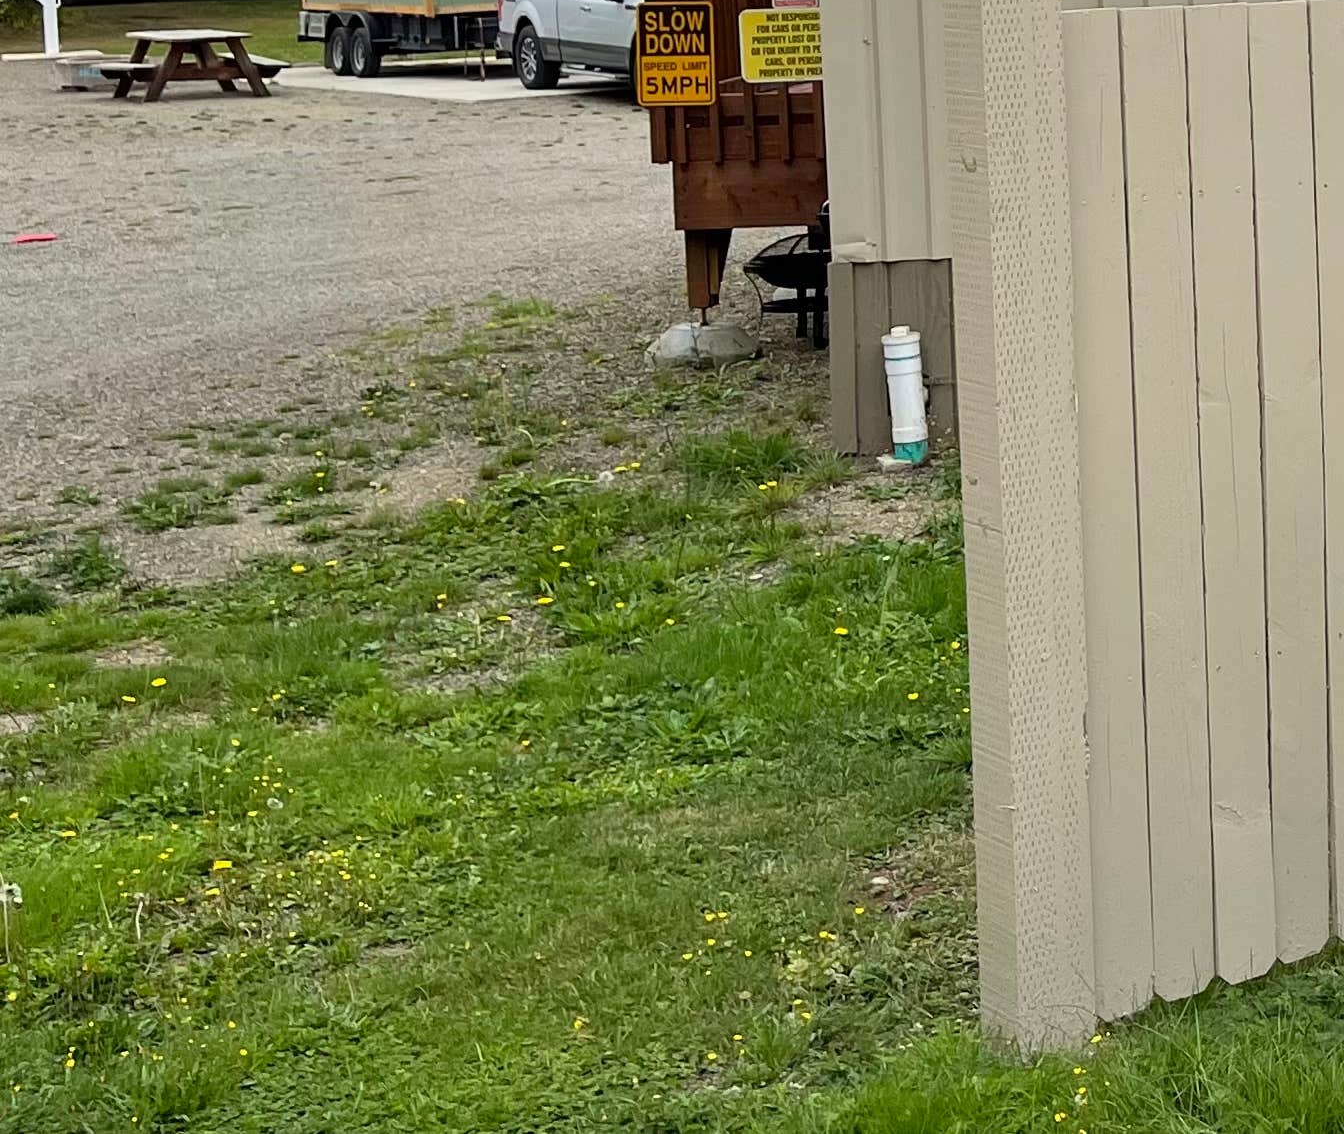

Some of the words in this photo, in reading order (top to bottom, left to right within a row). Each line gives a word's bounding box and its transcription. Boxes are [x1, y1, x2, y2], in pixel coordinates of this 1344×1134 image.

[644, 10, 705, 33] SLOW
[766, 13, 780, 22] NOT
[757, 25, 770, 34] FOR
[771, 24, 790, 33] CARS
[791, 24, 801, 33] OR
[645, 33, 706, 54] DOWN
[752, 35, 786, 45] PROPERTY
[788, 34, 805, 44] LOST
[806, 34, 816, 43] OR
[751, 47, 761, 56] OR
[763, 47, 776, 56] FOR
[802, 45, 811, 54] TO
[643, 61, 678, 72] SPEED
[682, 61, 708, 71] LIMIT
[759, 68, 793, 78] PROPERTY
